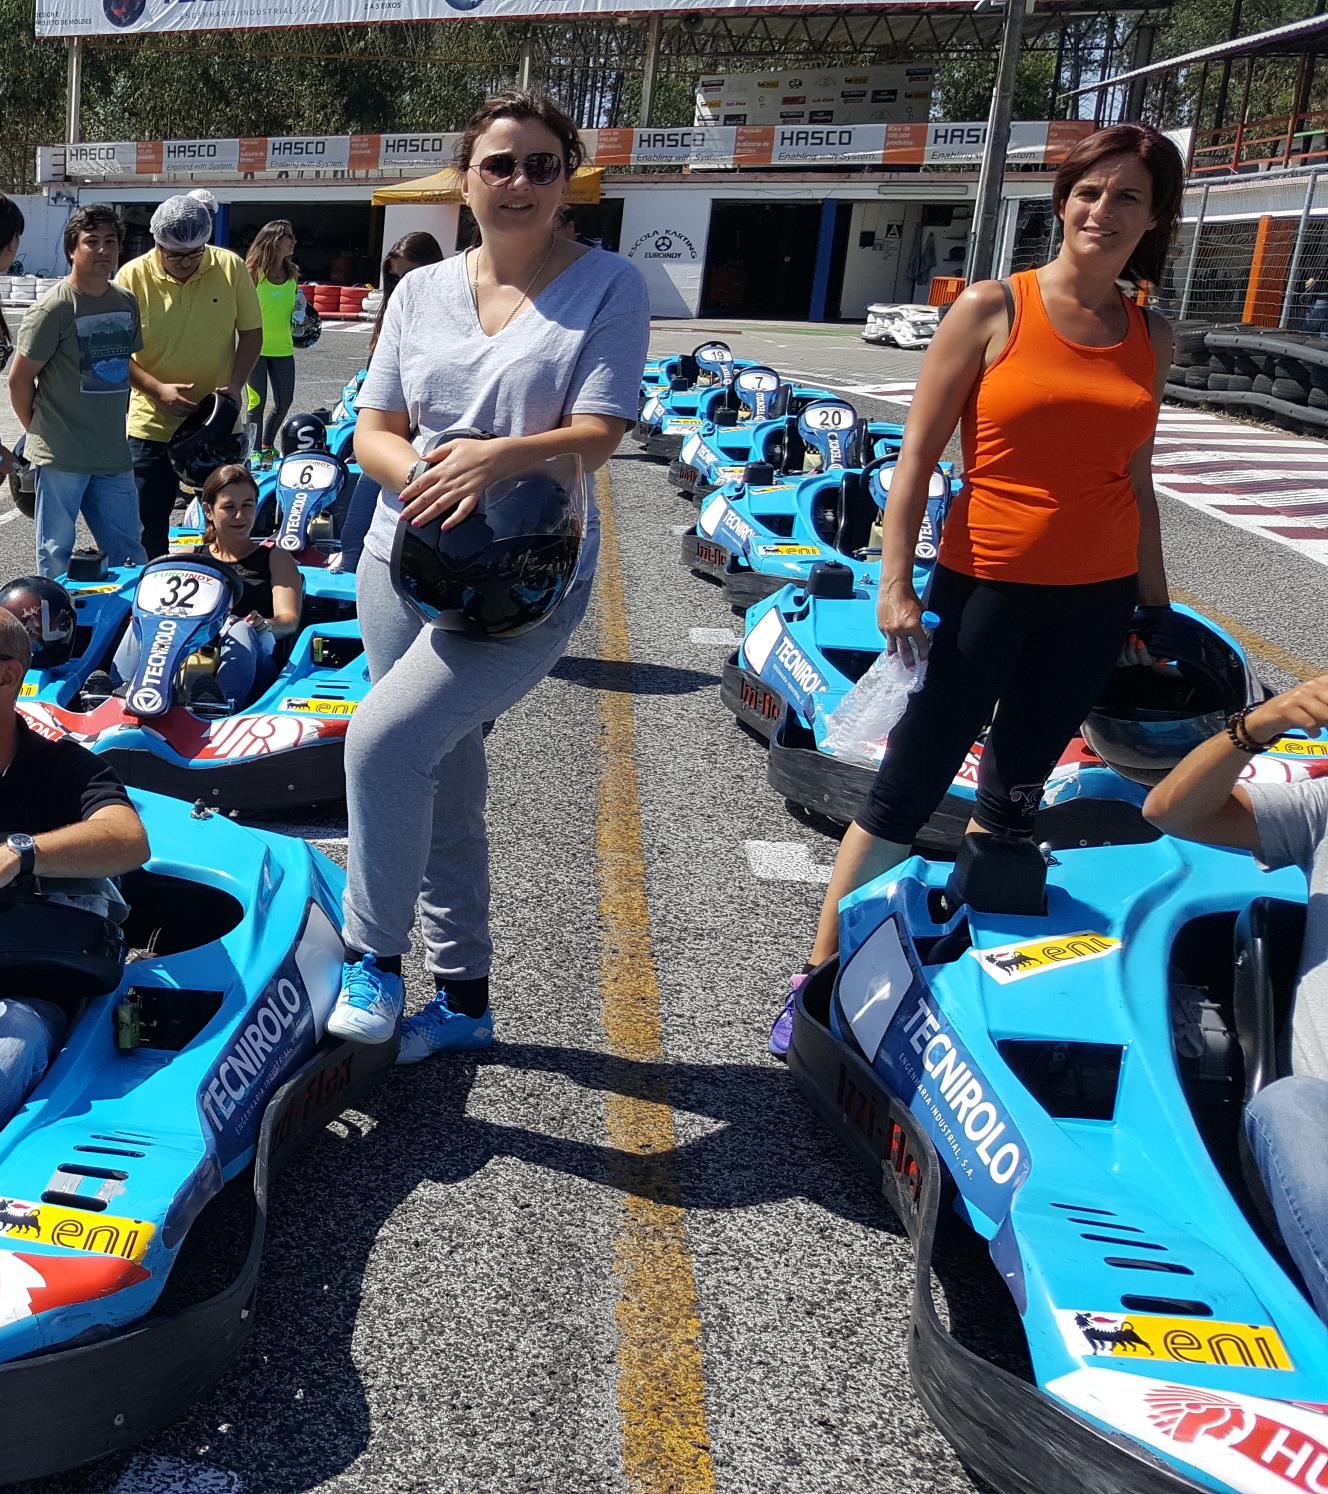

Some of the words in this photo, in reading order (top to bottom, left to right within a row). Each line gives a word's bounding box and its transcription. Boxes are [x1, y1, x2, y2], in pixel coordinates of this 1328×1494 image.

[638, 132, 704, 148] HASCO
[780, 130, 852, 146] HASCO
[933, 128, 988, 145] HAS
[167, 144, 217, 158] HASCO
[271, 141, 325, 156] HASCO
[385, 138, 443, 153] HASCO
[69, 147, 115, 161] HASCO
[636, 154, 672, 163] Enabling
[777, 152, 816, 161] Enabling
[1007, 151, 1039, 161] ystem.
[628, 230, 659, 258] ESCOLA
[665, 229, 698, 259] KARTING
[711, 351, 724, 360] 19
[755, 376, 764, 389] 7
[819, 410, 841, 426] 20
[296, 426, 314, 451] S
[299, 465, 314, 484] 6
[153, 572, 214, 584] EUROINDY
[160, 576, 199, 608] 32
[141, 620, 178, 686] TECNIROLO
[1284, 742, 1328, 756] en
[1048, 934, 1119, 962] eni
[203, 978, 301, 1133] TECNIROLO
[903, 997, 1020, 1185] TECNIROLO
[235, 1087, 265, 1136] ENGENHARIA
[898, 1052, 933, 1106] ENGENHARIA
[930, 1105, 961, 1161] INDUSTRIAL,
[960, 1159, 974, 1181] S.A.
[50, 1217, 142, 1259] eni
[1163, 1323, 1280, 1369] eni
